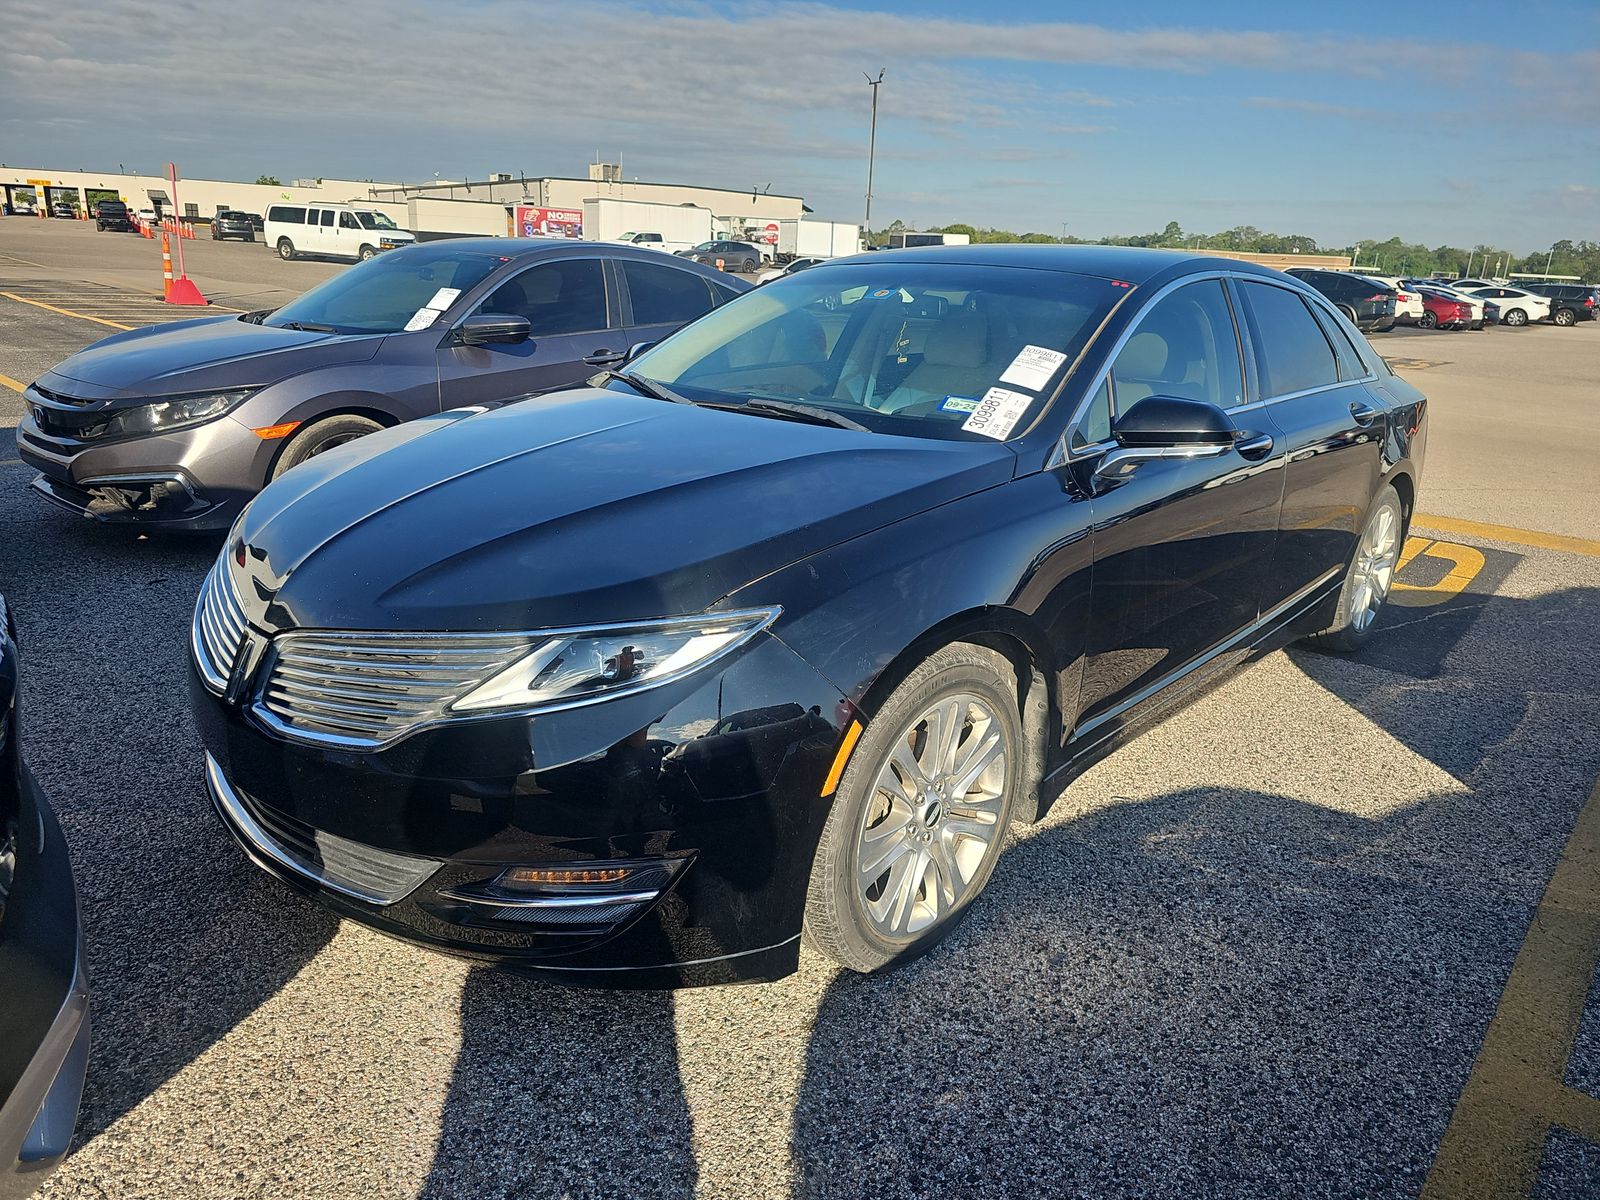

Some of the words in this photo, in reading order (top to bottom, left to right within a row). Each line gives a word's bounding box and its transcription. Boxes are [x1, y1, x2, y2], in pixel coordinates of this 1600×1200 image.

[546, 211, 564, 220] NO
[1025, 347, 1064, 362] 3099811
[969, 390, 1007, 429] 3099811
